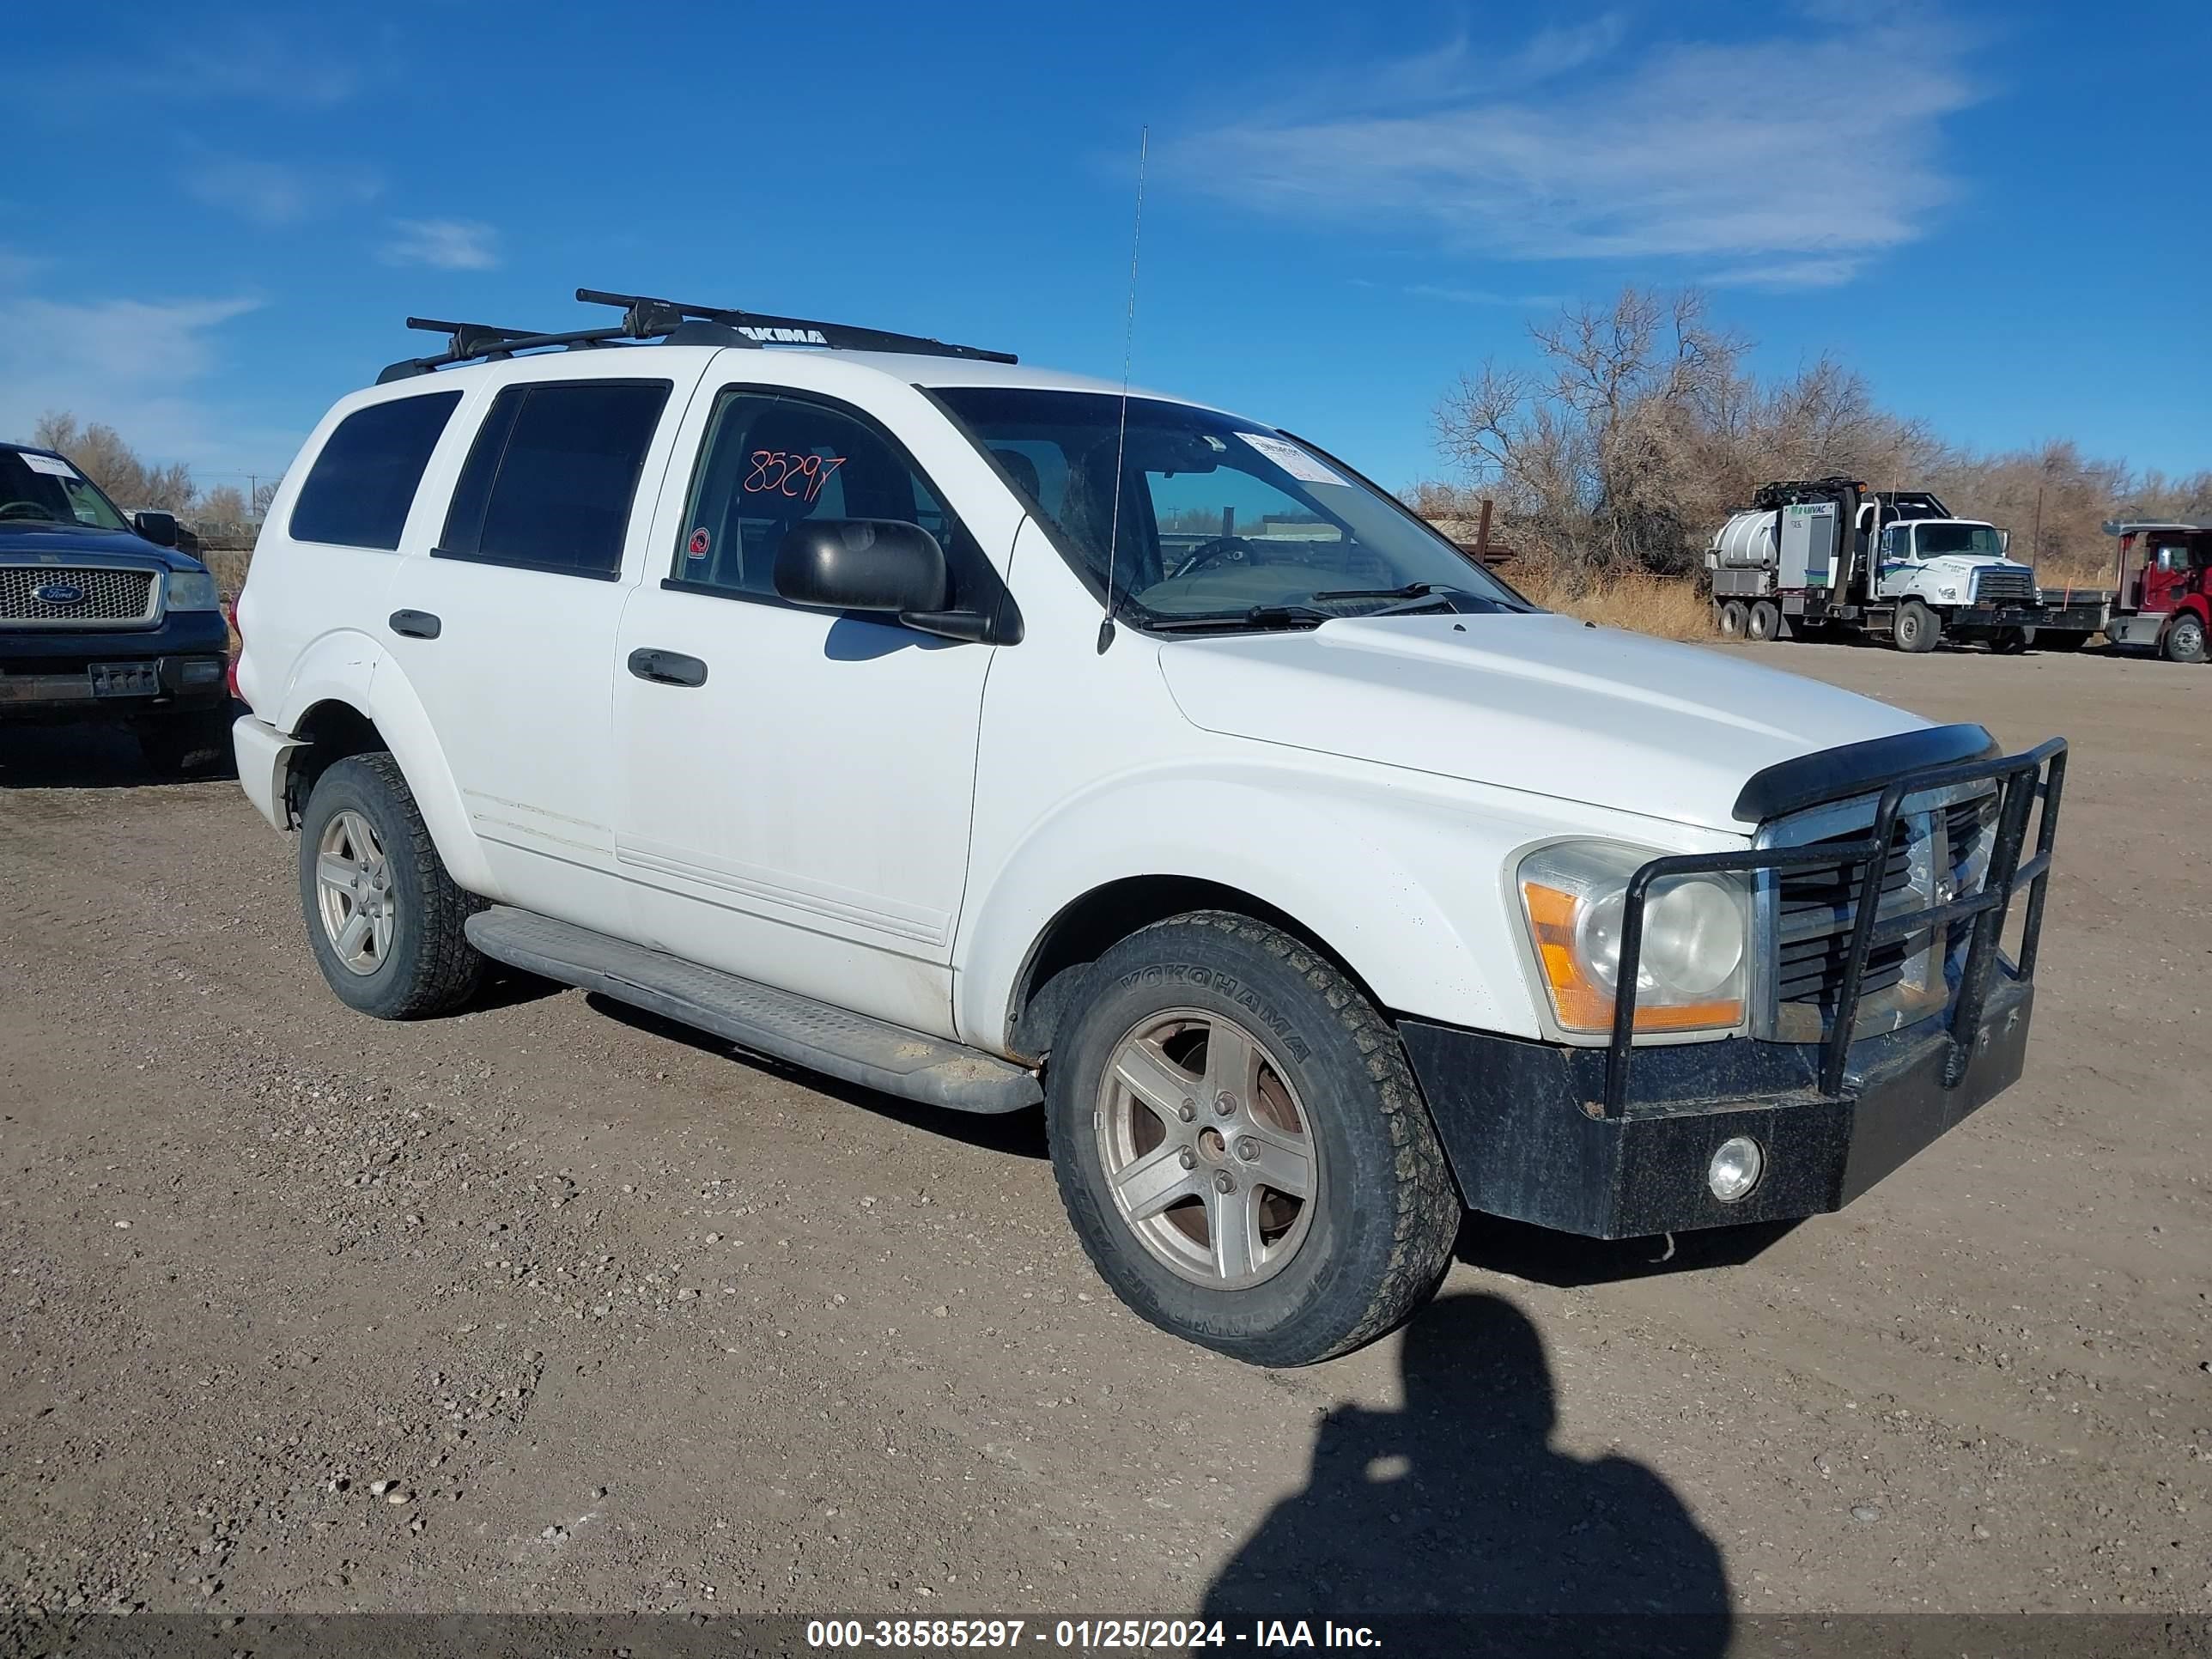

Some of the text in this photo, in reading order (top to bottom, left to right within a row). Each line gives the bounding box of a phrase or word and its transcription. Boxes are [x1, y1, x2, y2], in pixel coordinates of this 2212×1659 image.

[731, 326, 829, 343] AKIMA
[744, 450, 847, 502] 85297
[46, 587, 74, 599] Ford
[1120, 963, 1311, 1065] YOKOHAMA
